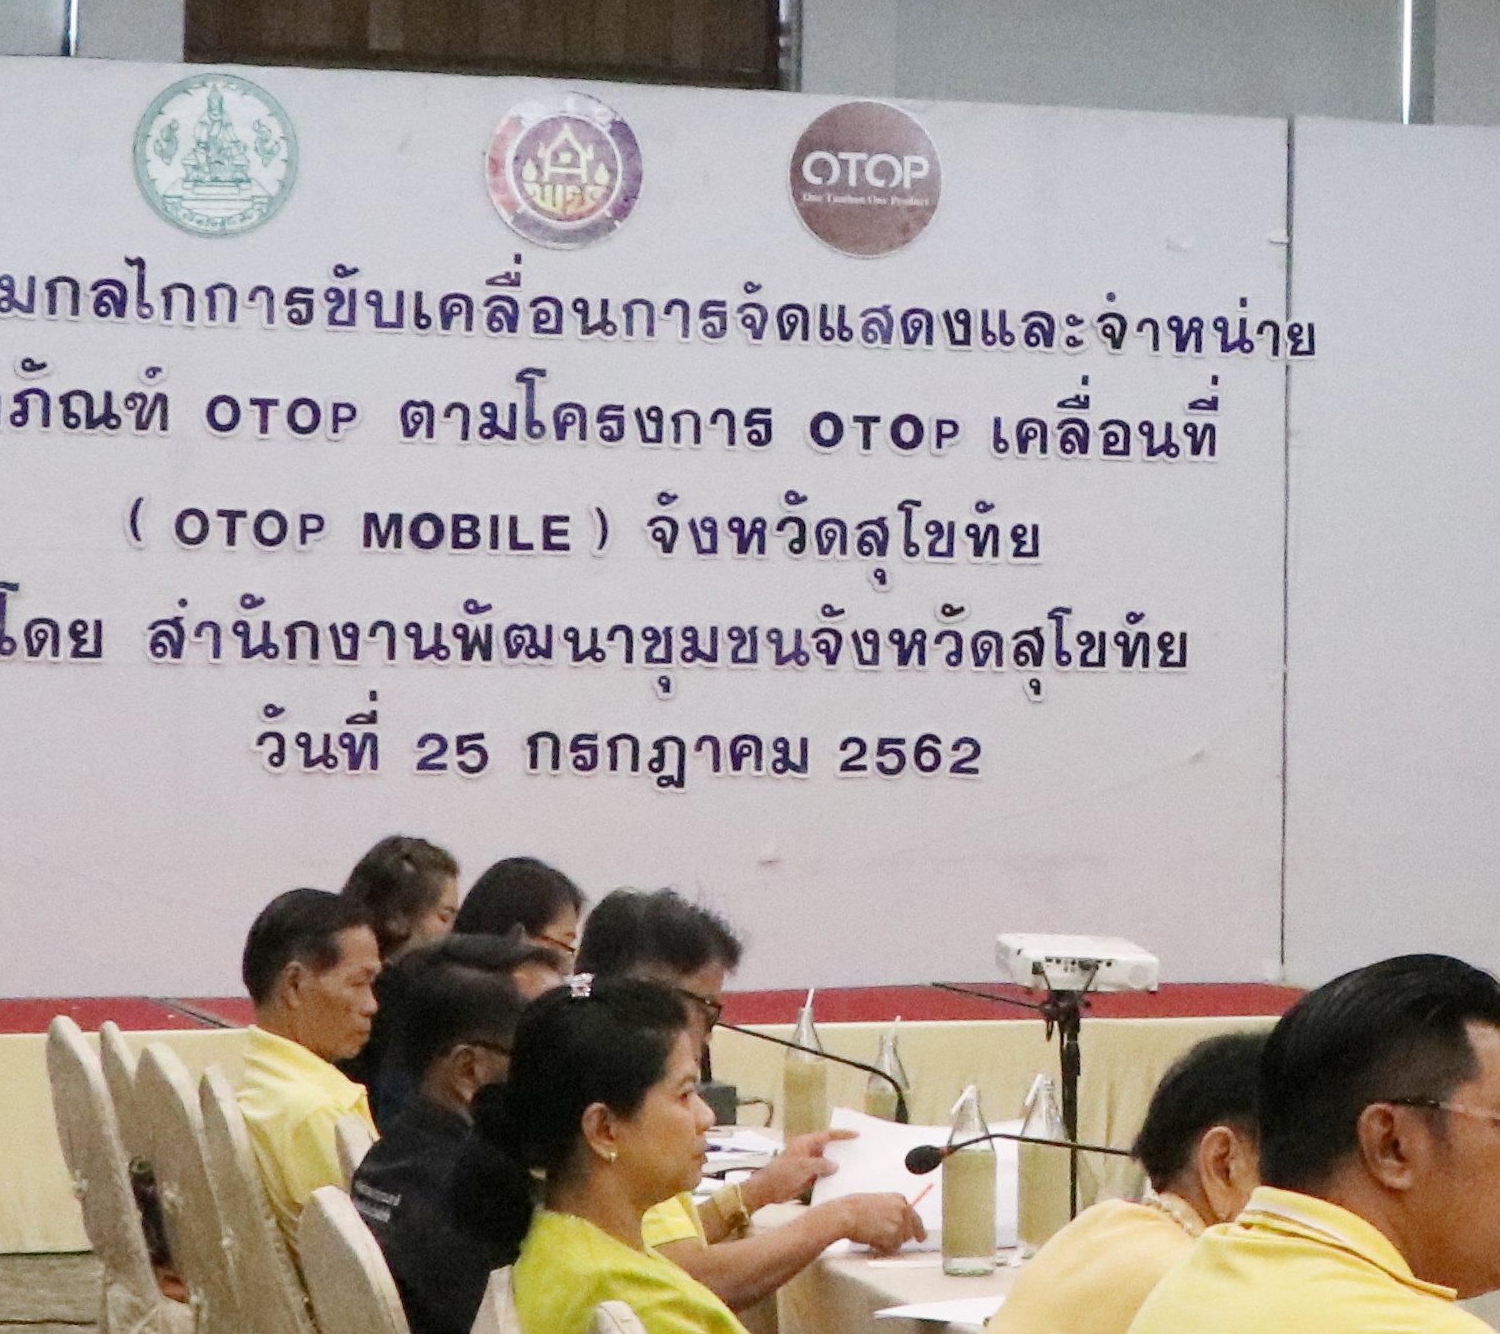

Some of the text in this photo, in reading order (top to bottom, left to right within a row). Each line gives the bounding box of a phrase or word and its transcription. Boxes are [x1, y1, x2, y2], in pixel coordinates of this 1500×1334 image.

[802, 150, 930, 189] OTOP
[205, 394, 357, 435] OTOP
[400, 367, 773, 444] ตามโครงการ
[809, 410, 960, 451] OTOP
[993, 374, 1219, 459] เคลื่อนที่
[647, 489, 1040, 586] จังหวัดสุโขทัย
[147, 593, 1188, 697] สำนักงานพัฒนาชุมชนจังหวัดสุโขทัย
[256, 690, 982, 789] วันที่ 25 กรกฎาคม 2562
